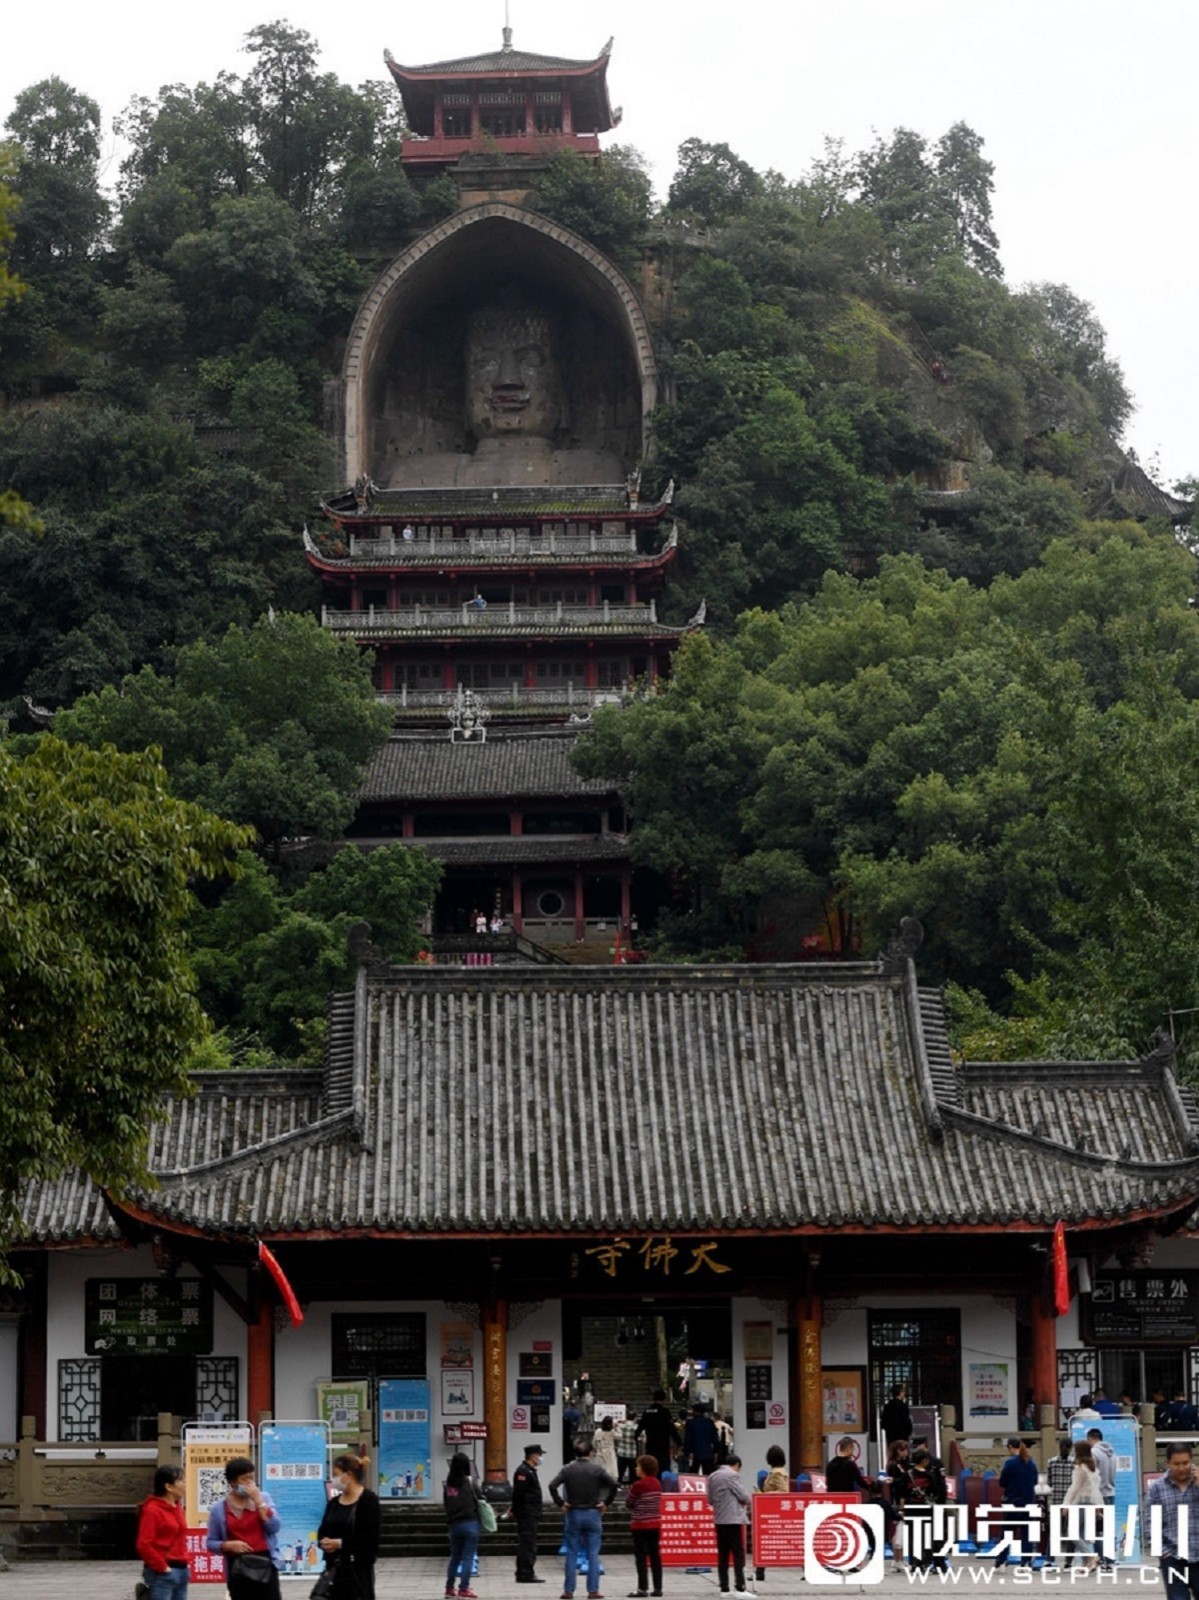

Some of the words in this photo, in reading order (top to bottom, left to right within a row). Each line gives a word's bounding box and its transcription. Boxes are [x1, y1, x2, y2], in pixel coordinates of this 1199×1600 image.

[585, 1236, 732, 1277] 大佛寺
[99, 1281, 200, 1300] 团体票
[1119, 1279, 1189, 1298] 售票处
[99, 1307, 200, 1325] 网络票
[682, 1479, 707, 1492] 入口
